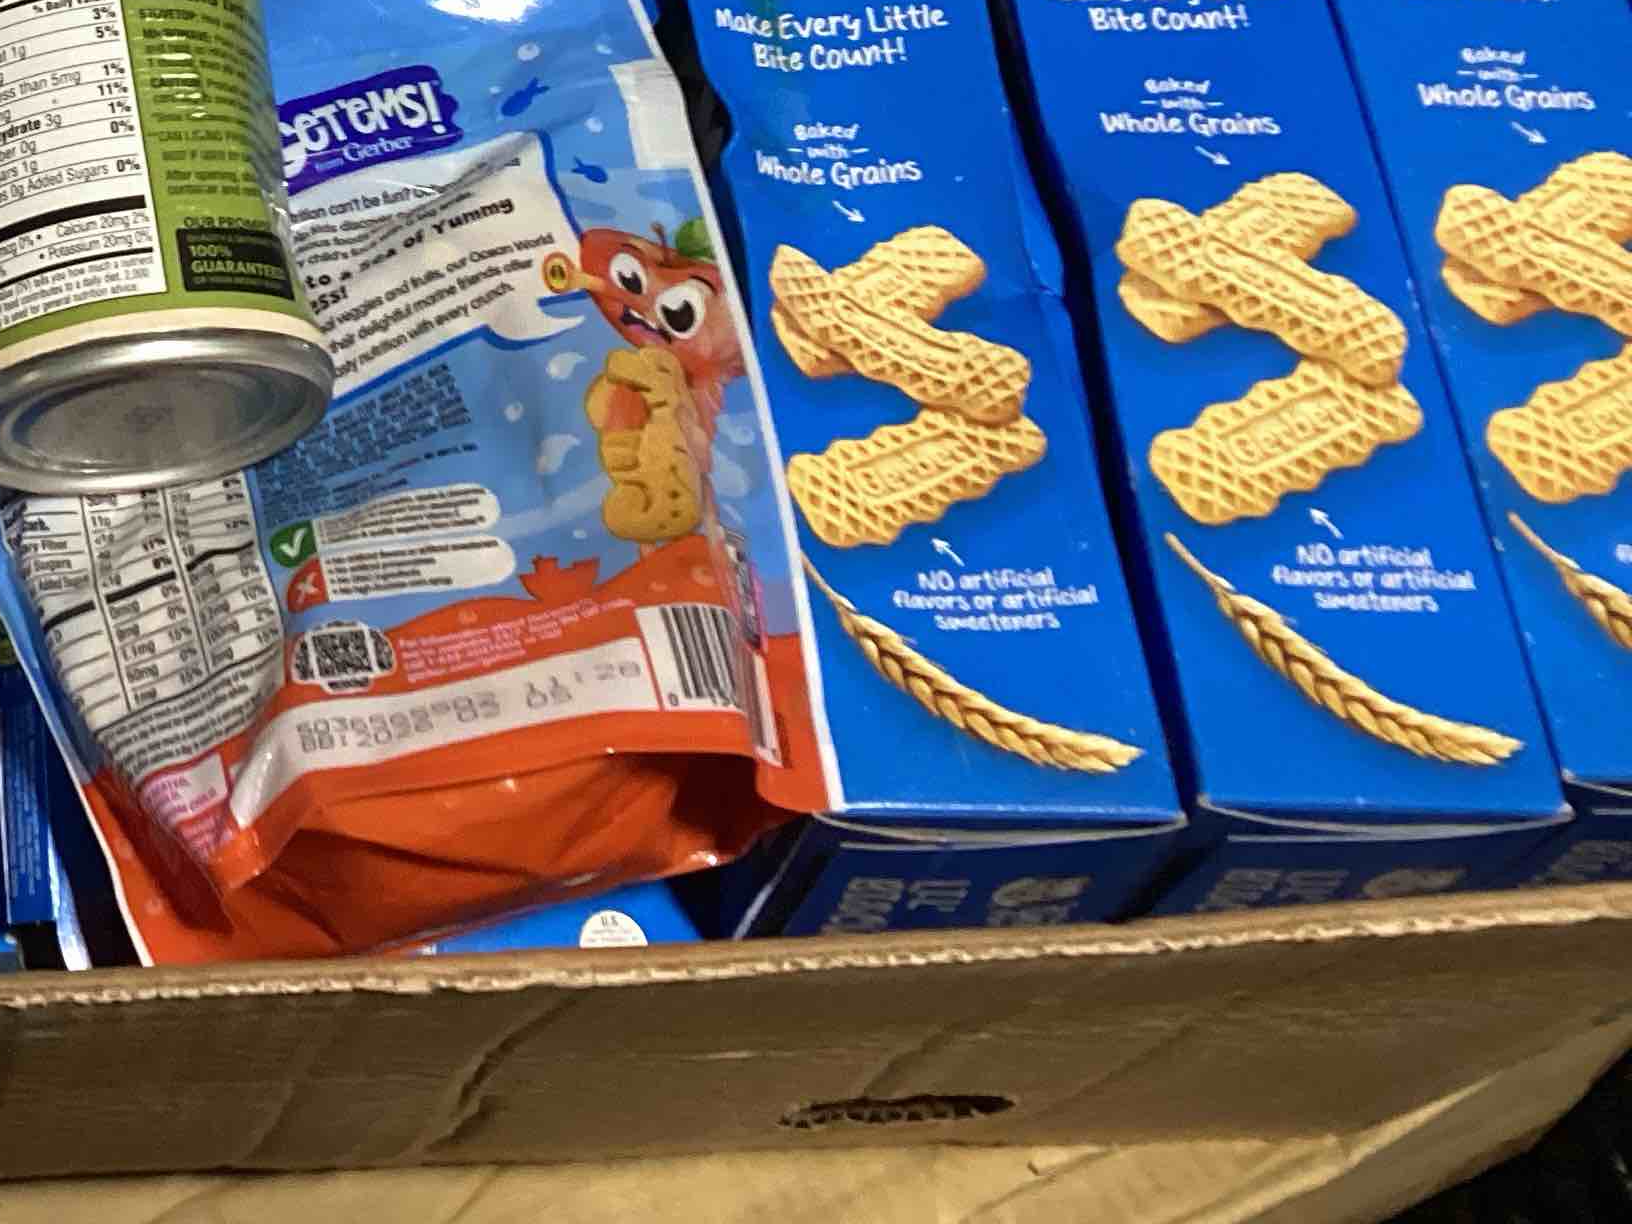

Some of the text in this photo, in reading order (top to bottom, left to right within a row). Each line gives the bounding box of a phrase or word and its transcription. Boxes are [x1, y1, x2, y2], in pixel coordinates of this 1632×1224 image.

[716, 4, 949, 40] Make Every Little
[1088, 4, 1250, 32] Bite Count!
[754, 37, 907, 72] Bite Count!
[1418, 83, 1596, 111] Whole Grains
[1100, 112, 1282, 138] Whole Grains
[344, 138, 413, 162] Gerber
[756, 150, 923, 190] Whole Grains
[431, 198, 515, 235] Yummy
[918, 570, 955, 591] NO
